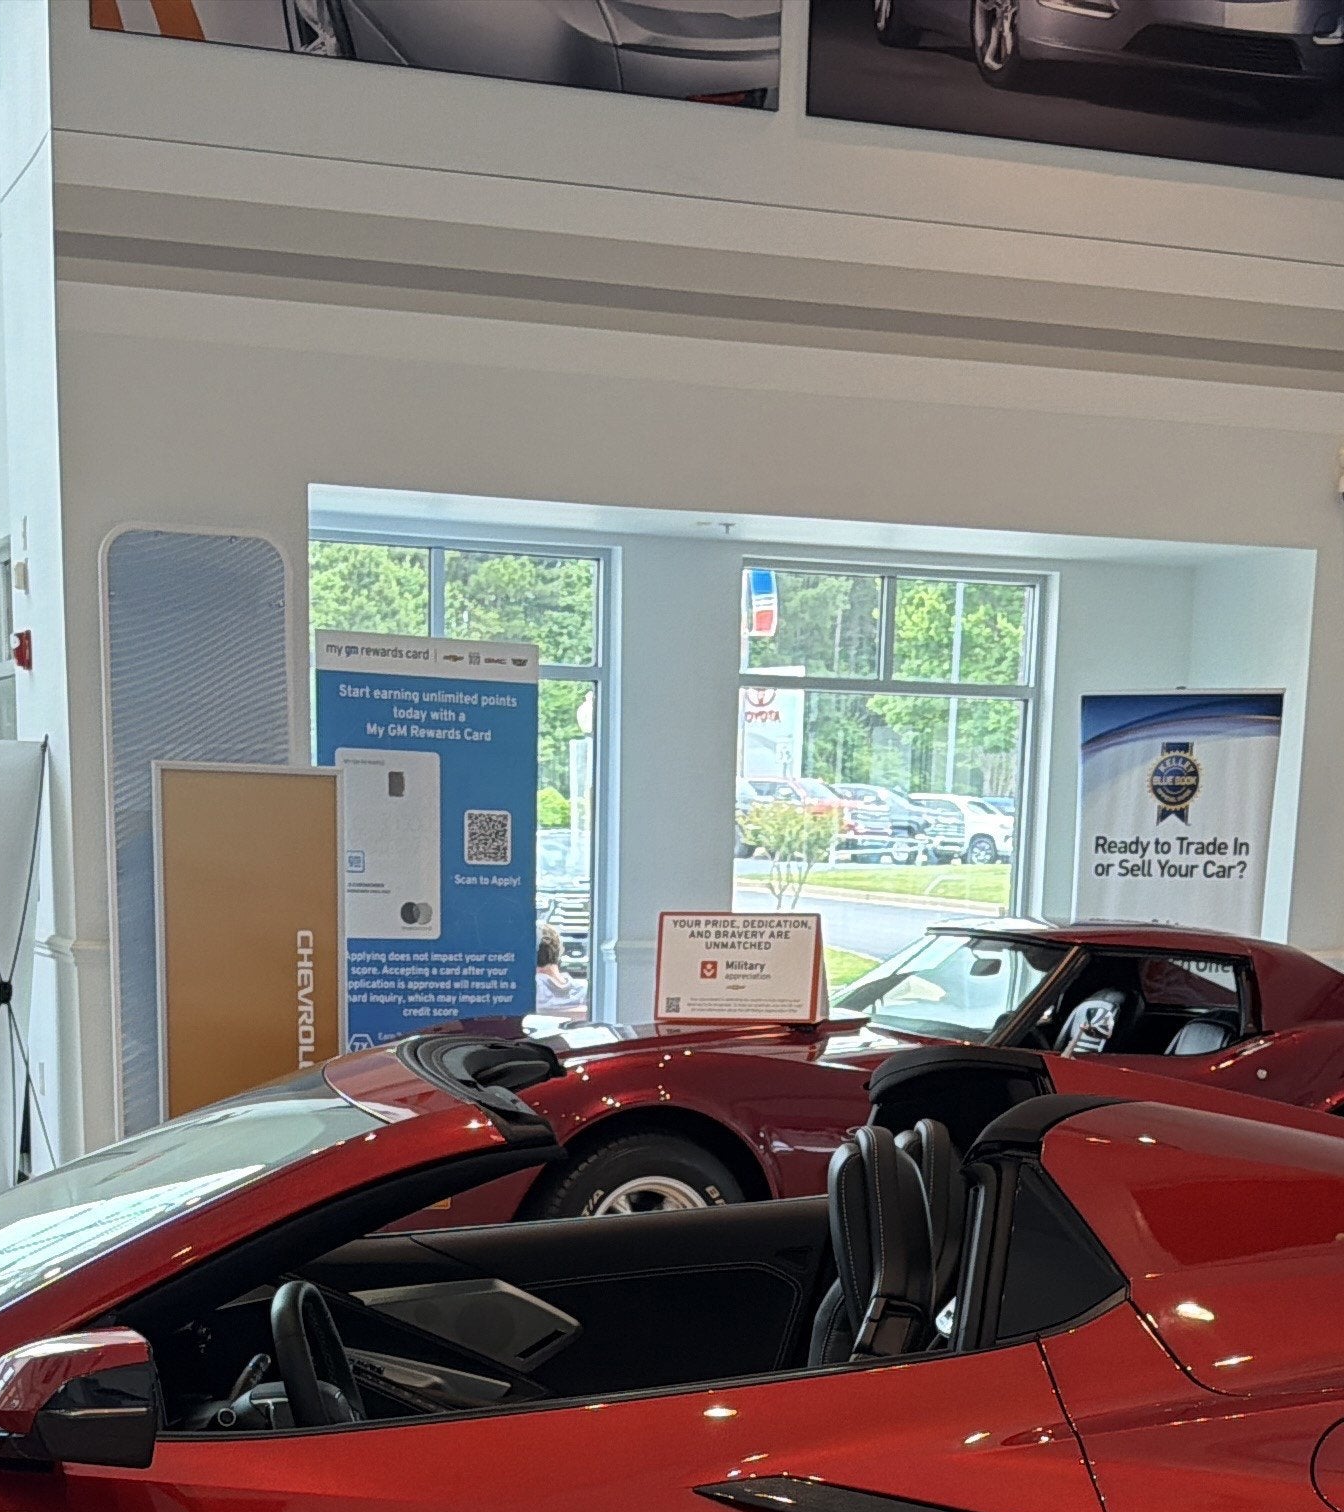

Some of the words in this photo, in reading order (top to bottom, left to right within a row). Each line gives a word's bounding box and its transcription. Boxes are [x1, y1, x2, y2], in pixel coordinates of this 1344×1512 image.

[361, 646, 404, 659] rewards
[405, 648, 429, 661] card
[339, 684, 370, 699] Start
[373, 688, 420, 704] earning
[422, 690, 479, 706] unlimited
[480, 694, 517, 708] points
[392, 706, 427, 723] today
[430, 708, 456, 721] with
[458, 713, 466, 722] a
[366, 723, 385, 739] My
[387, 724, 407, 737] GM
[410, 725, 461, 740] Rewards
[463, 728, 492, 742] Card
[1094, 836, 1150, 859] Ready
[1154, 838, 1171, 855] to
[1175, 837, 1229, 856] Trade
[1233, 837, 1250, 856] In
[1094, 861, 1112, 877] or
[1118, 859, 1153, 877] Sell
[1158, 860, 1198, 878] Your
[1203, 861, 1248, 879] Car?
[454, 874, 478, 885] Scan
[480, 875, 489, 885] to
[490, 875, 522, 888] Apply!
[672, 919, 701, 929] YOUR
[704, 920, 740, 930] PRIDE,
[742, 920, 812, 930] DEDICATION,
[689, 930, 711, 939] AND
[714, 930, 766, 940] BRAVERY
[768, 930, 791, 940] ARE
[705, 941, 772, 951] UNMATCHED
[388, 952, 411, 962] does
[413, 952, 429, 962] not
[431, 952, 463, 963] impact
[465, 953, 486, 963] your
[488, 952, 515, 962] credit
[382, 965, 430, 977] Accepting
[440, 966, 460, 976] card
[462, 966, 485, 976] after
[487, 967, 509, 977] your
[725, 960, 766, 972] Military
[724, 973, 772, 981] appreciation
[348, 979, 396, 989] pplication
[407, 979, 452, 990] approved
[453, 979, 469, 989] will
[471, 980, 497, 989] result
[499, 980, 509, 989] in
[297, 929, 315, 1070] CHEVROL
[408, 993, 435, 1003] which
[436, 995, 457, 1005] may
[458, 994, 490, 1004] impact
[492, 995, 513, 1005] your
[403, 1007, 431, 1017] credit
[432, 1008, 458, 1017] score
